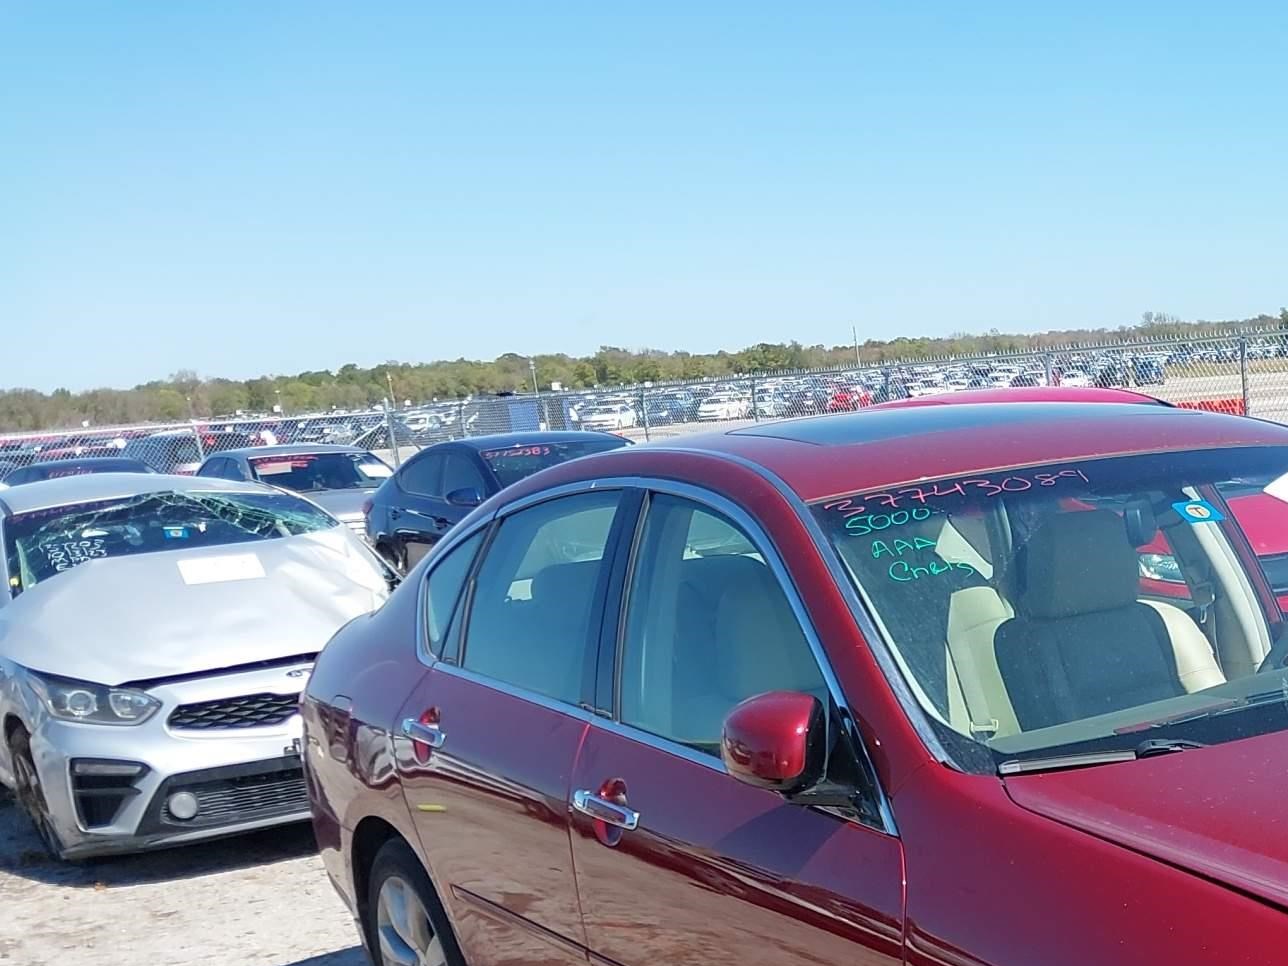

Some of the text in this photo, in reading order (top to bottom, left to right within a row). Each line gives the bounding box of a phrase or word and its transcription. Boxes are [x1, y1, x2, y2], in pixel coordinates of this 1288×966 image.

[824, 469, 1089, 517] 37743089
[845, 507, 930, 536] 5000
[871, 536, 937, 558] AAA
